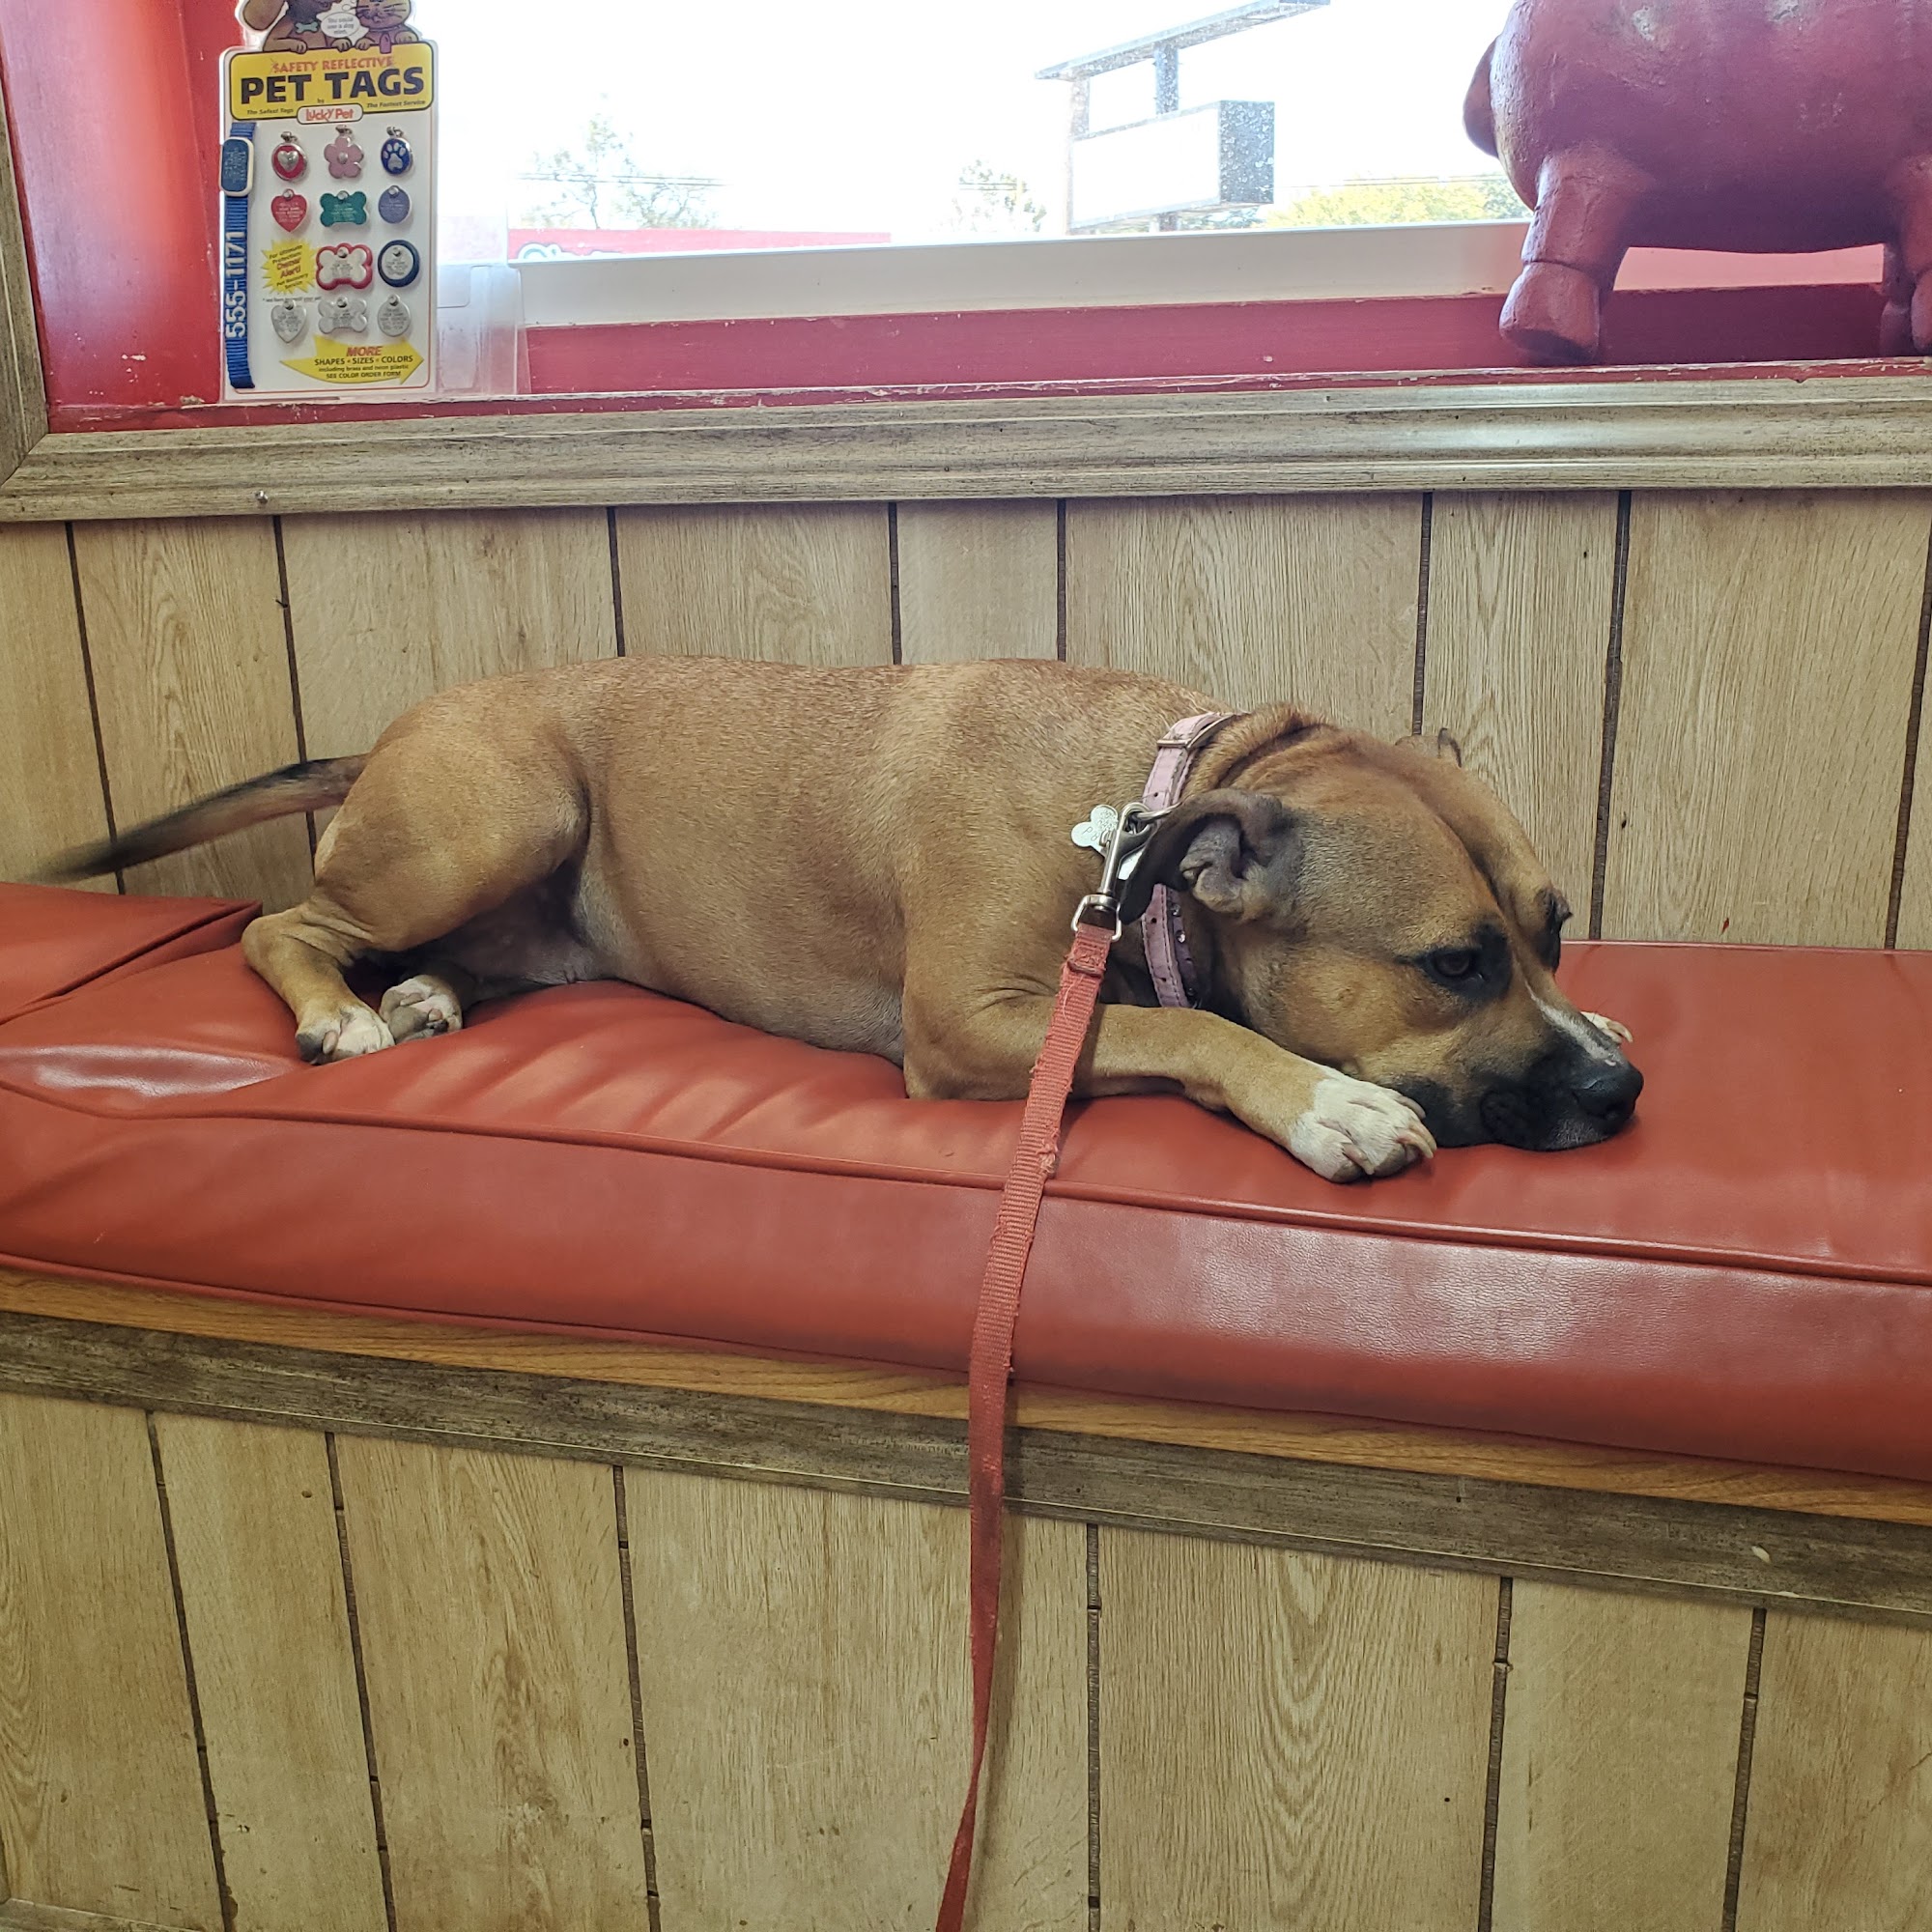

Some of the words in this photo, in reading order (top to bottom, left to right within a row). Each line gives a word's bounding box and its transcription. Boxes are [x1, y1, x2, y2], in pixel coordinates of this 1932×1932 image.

[272, 61, 319, 73] SAFETY
[322, 56, 393, 71] REFLECTIVE
[241, 73, 312, 104] PET
[325, 67, 424, 99] TAGS
[305, 108, 334, 122] Lucky
[335, 108, 354, 119] Pet
[225, 231, 246, 338] 555-1171
[346, 345, 384, 357] MORE
